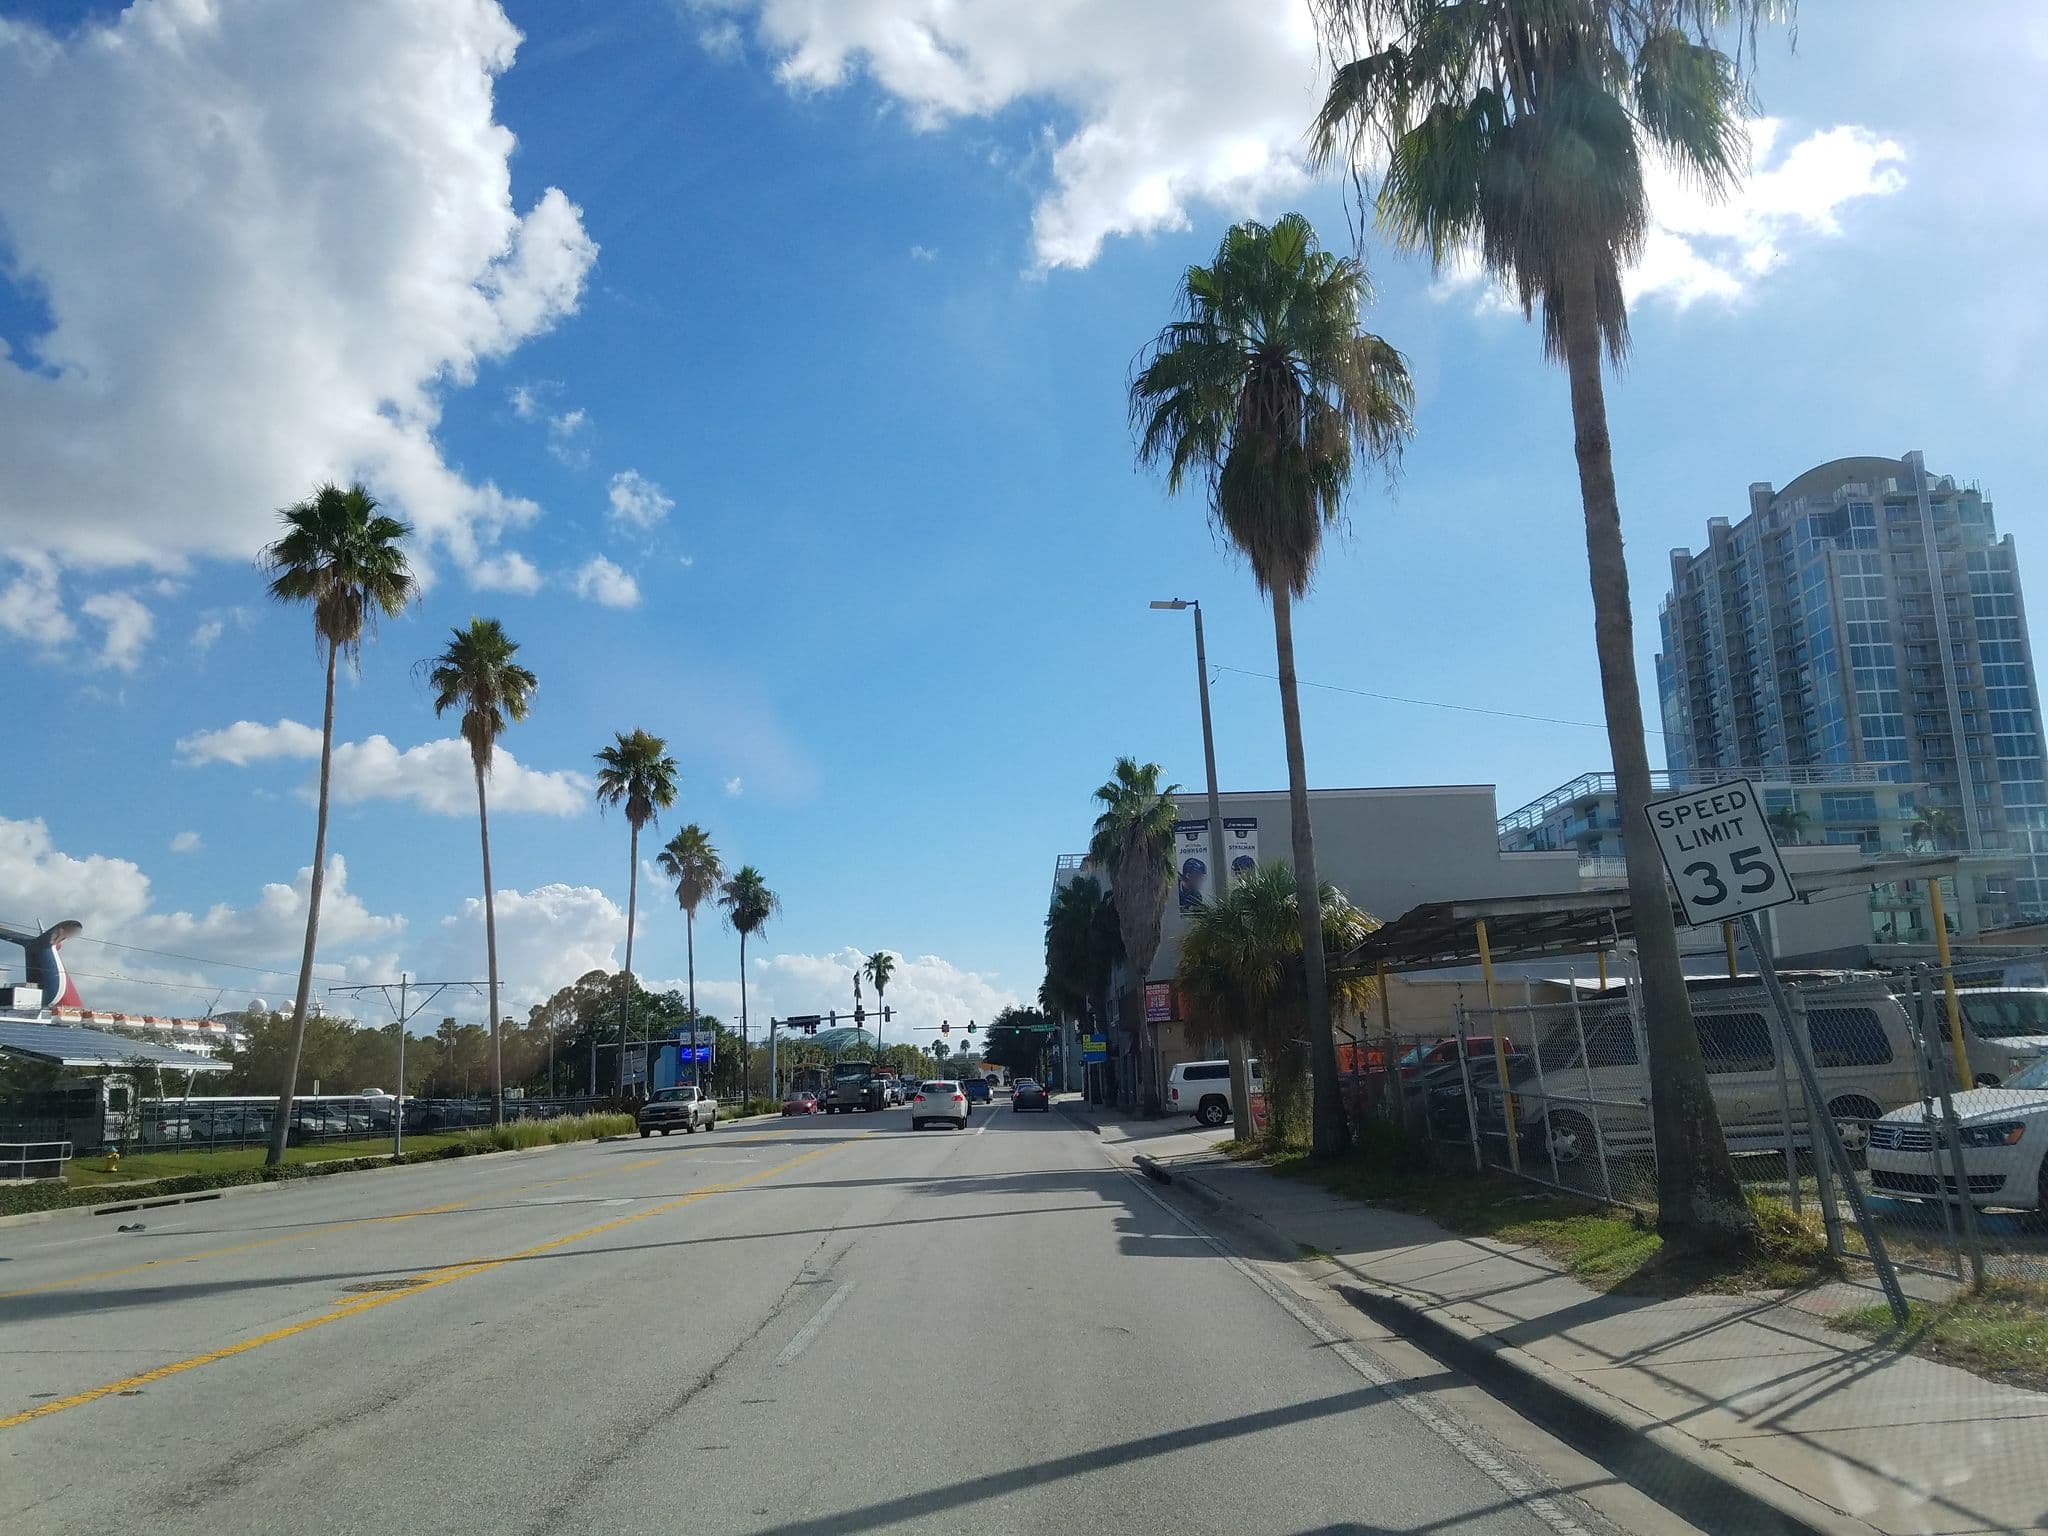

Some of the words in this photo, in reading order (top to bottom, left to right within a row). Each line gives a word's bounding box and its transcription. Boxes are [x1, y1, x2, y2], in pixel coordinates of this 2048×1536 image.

[1657, 790, 1747, 829] SPEED
[1674, 817, 1744, 852] LIMIT
[1683, 846, 1776, 906] 35
